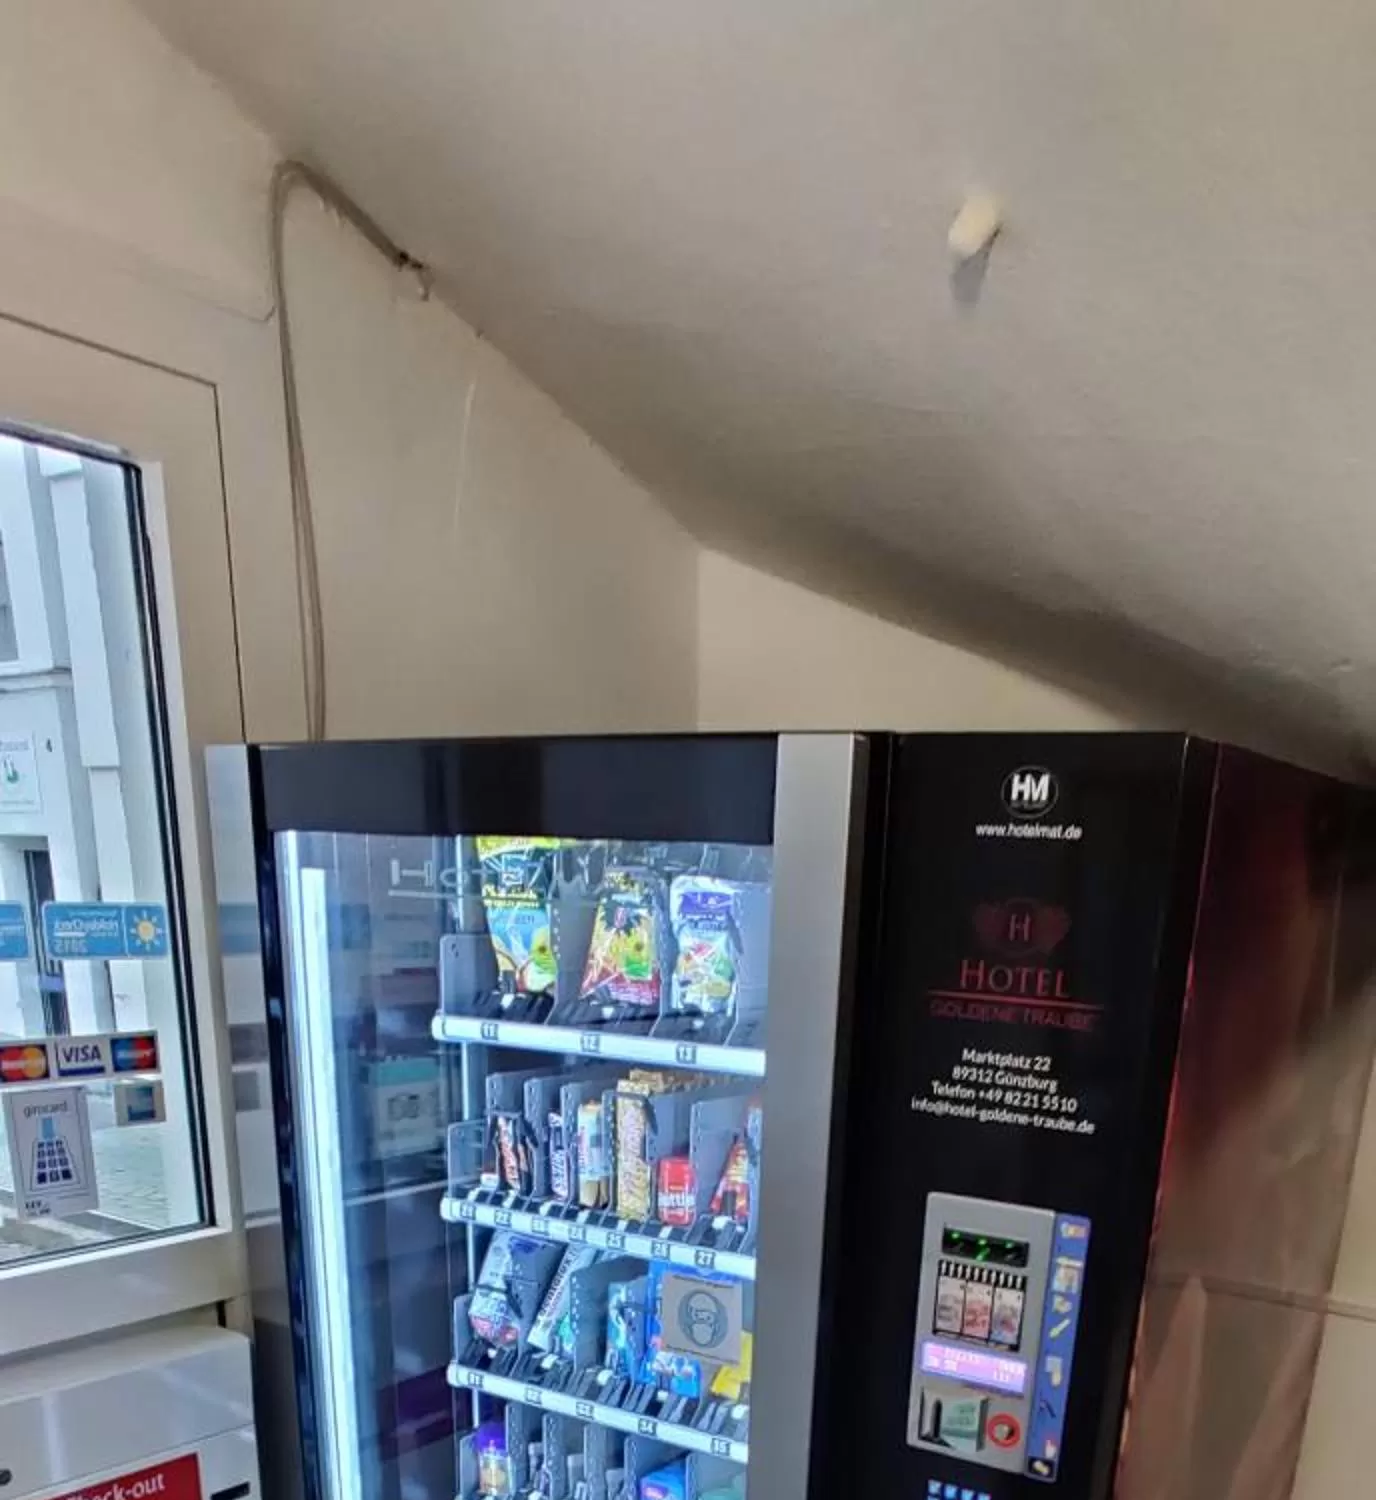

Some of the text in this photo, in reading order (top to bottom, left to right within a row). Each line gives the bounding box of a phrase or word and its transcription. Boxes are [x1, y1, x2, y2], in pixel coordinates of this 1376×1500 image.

[1011, 773, 1050, 801] HM
[975, 822, 1083, 840] www.hotelmat.de
[1009, 912, 1031, 942] H
[960, 959, 1069, 998] HOTEL
[930, 998, 1096, 1032] GOLDENE TRAUBE
[62, 1044, 101, 1063] VISA
[962, 1048, 1052, 1072] Marktplatz 22
[931, 1080, 976, 1099] Telefon
[978, 1087, 1003, 1103] +49
[952, 1065, 1058, 1094] 89312 Günzburg
[911, 1096, 1096, 1134] info@hotel-goldene-traube.de
